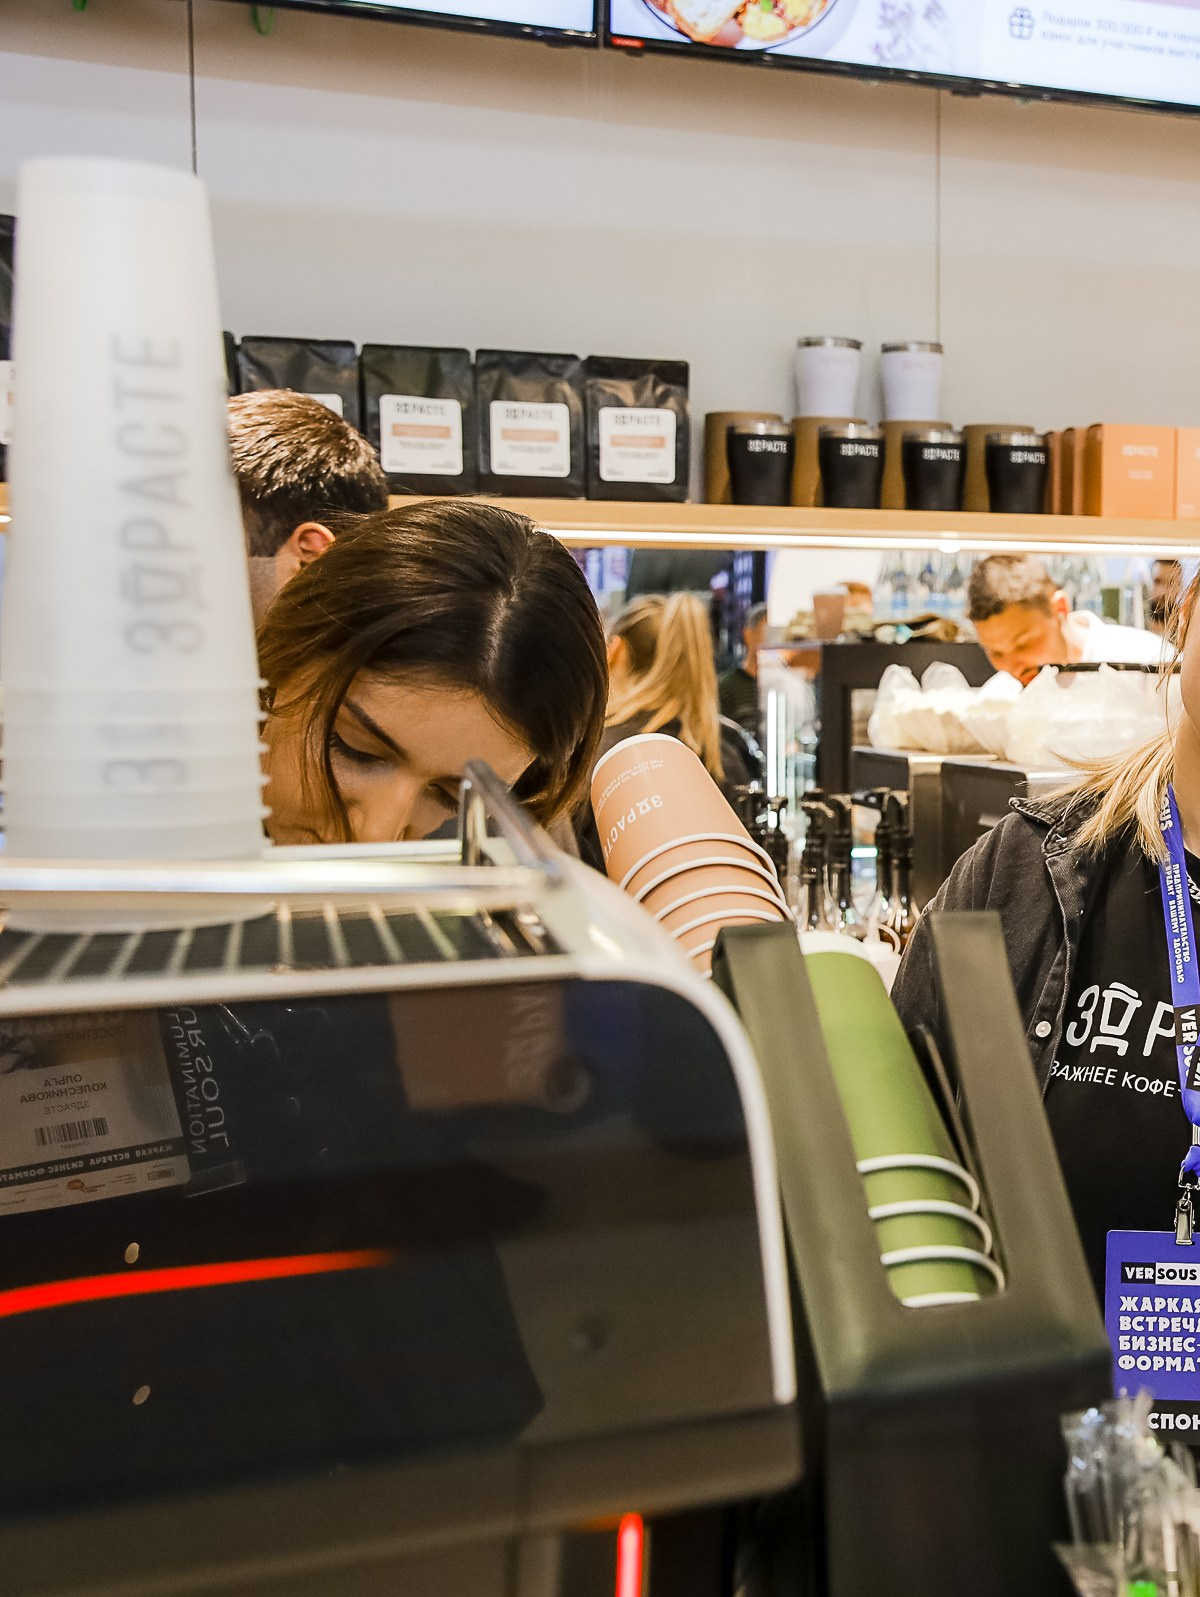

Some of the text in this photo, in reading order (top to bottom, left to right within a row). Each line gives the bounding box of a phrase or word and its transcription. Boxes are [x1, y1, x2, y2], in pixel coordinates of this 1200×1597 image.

[1168, 900, 1179, 934] ВАШЕМУ
[1172, 863, 1191, 963] ПРЕДПРИНИМАТЕЛЬСТВО
[1173, 939, 1185, 983] ЗДОРОВЬЮ
